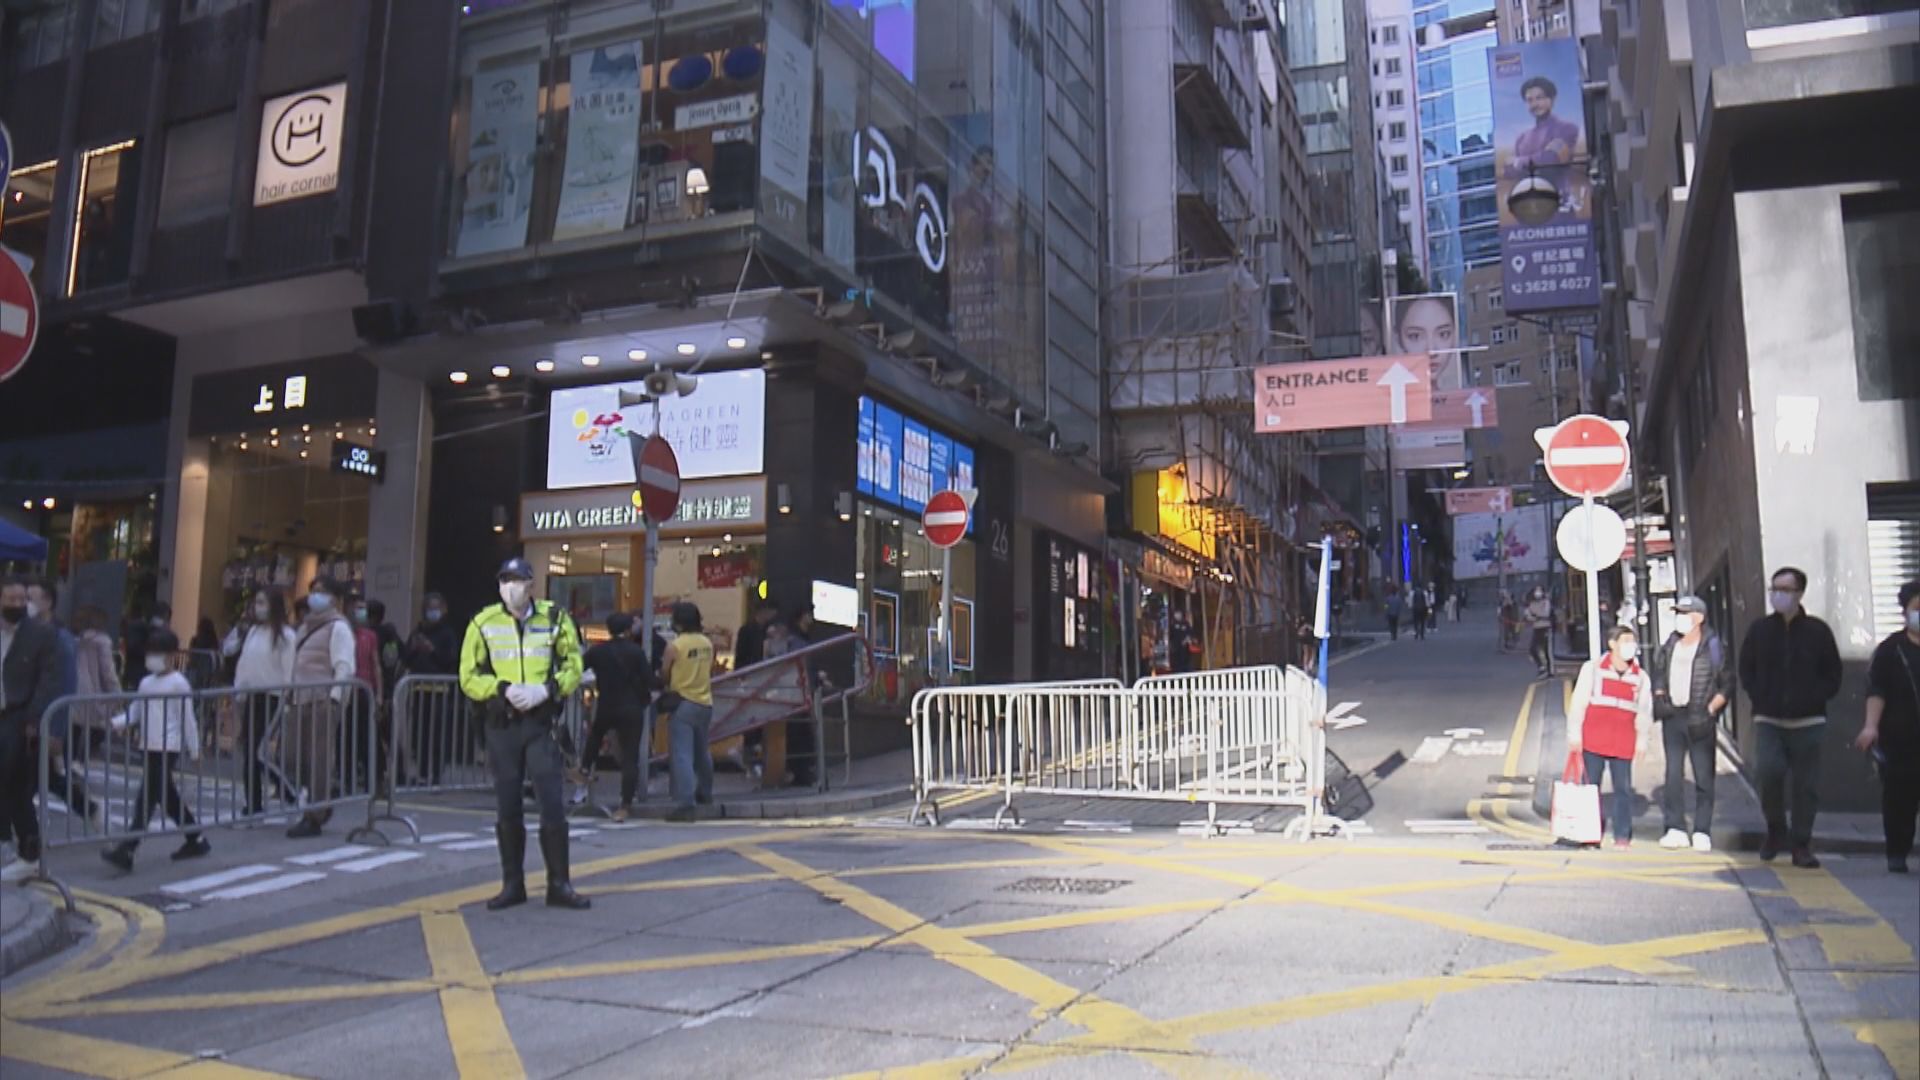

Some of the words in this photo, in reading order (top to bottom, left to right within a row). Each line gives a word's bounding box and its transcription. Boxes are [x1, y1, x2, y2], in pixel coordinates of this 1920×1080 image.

[260, 181, 288, 201] hair
[290, 172, 338, 195] corner
[1525, 280, 1558, 293] 3628
[1559, 276, 1592, 290] 4027
[1265, 368, 1369, 389] ENTRANCE
[1265, 393, 1296, 408] 入口
[533, 511, 572, 530] VITA
[576, 505, 637, 528] GREEN
[991, 519, 1009, 554] 26
